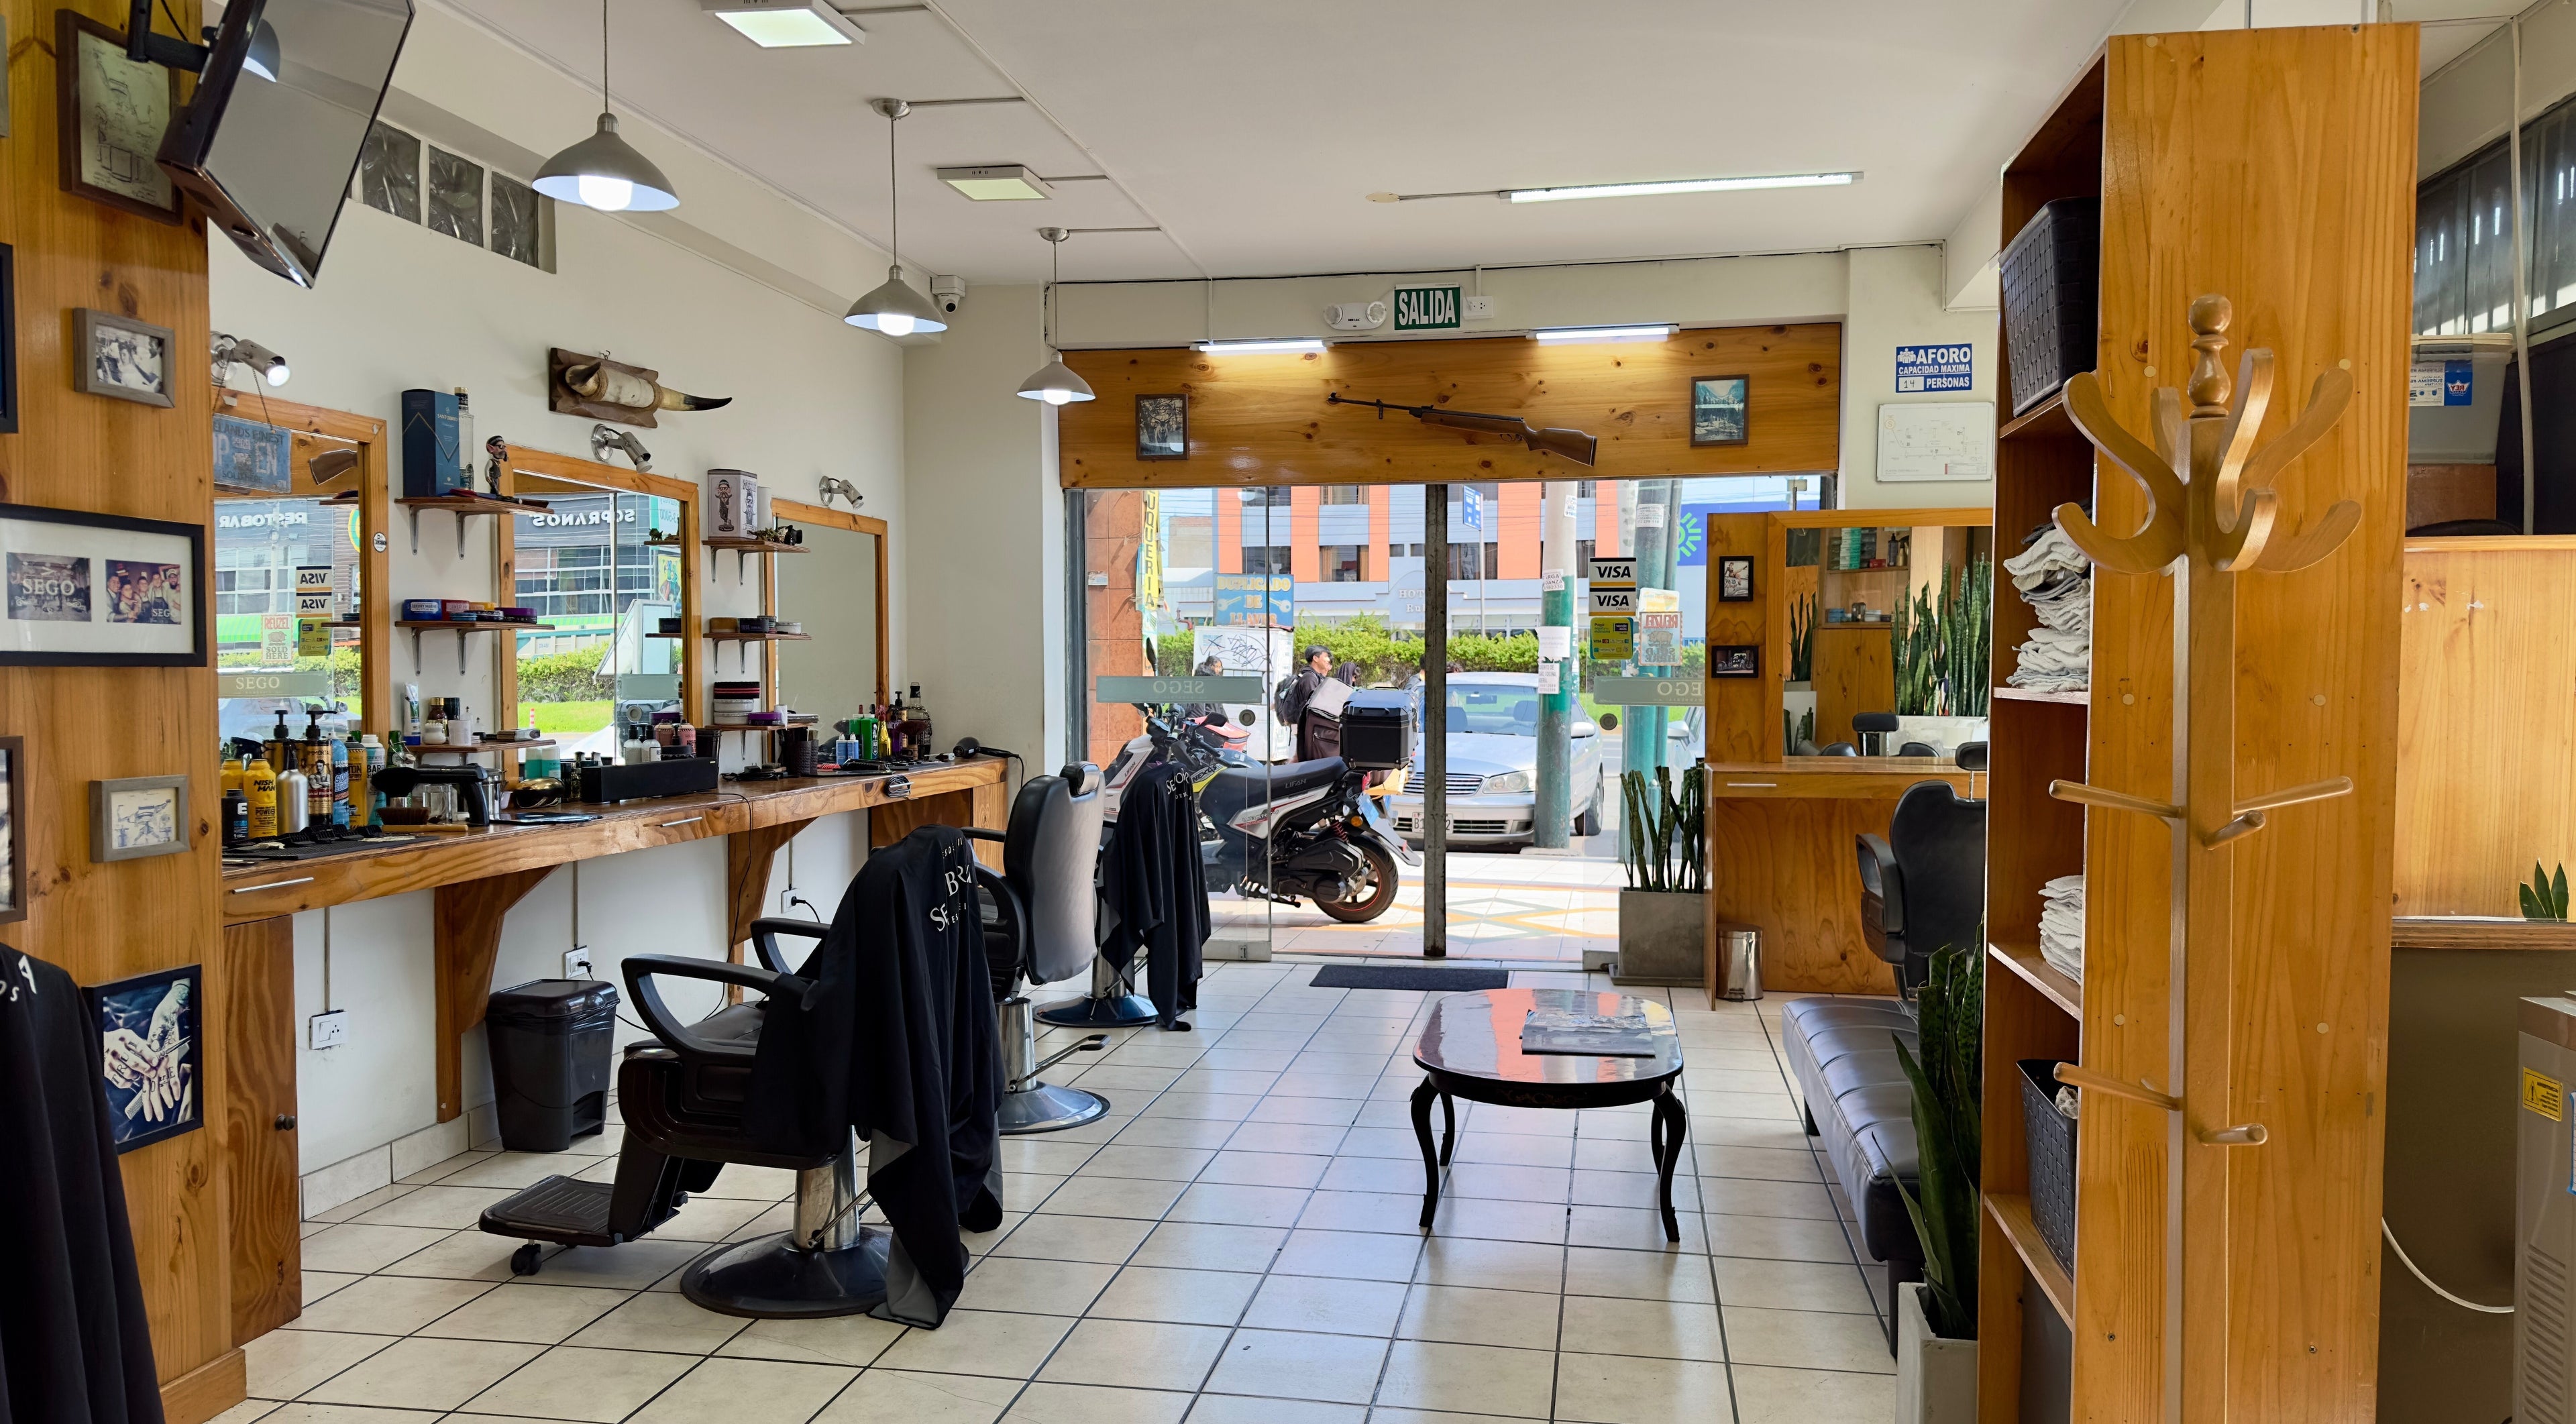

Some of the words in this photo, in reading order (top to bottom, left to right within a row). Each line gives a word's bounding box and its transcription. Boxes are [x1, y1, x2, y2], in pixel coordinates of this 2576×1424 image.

[1398, 290, 1456, 326] SALIDA
[1916, 347, 1971, 364] AFORO
[1898, 365, 1939, 374] CAPACIDAD
[1941, 364, 1970, 373] MAXIMA
[1904, 380, 1915, 388] 14
[1926, 376, 1970, 388] PERSONAS
[213, 420, 251, 438] ELANDS
[252, 429, 285, 446] FINEST
[1144, 490, 1156, 608] UQUERIA
[1595, 565, 1631, 578] VISA
[22, 578, 75, 596] SEGO
[1217, 576, 1291, 592] DUPLICADO
[1399, 590, 1425, 598] HOT
[1595, 595, 1629, 606] VISA
[1245, 594, 1263, 609] DE
[152, 608, 170, 618] SEG
[264, 617, 289, 629] REUZEL
[235, 676, 280, 690] SEGO
[1124, 761, 1136, 777] LIFAN
[1285, 779, 1307, 788] LIFAN
[1242, 810, 1280, 822] LIBERY
